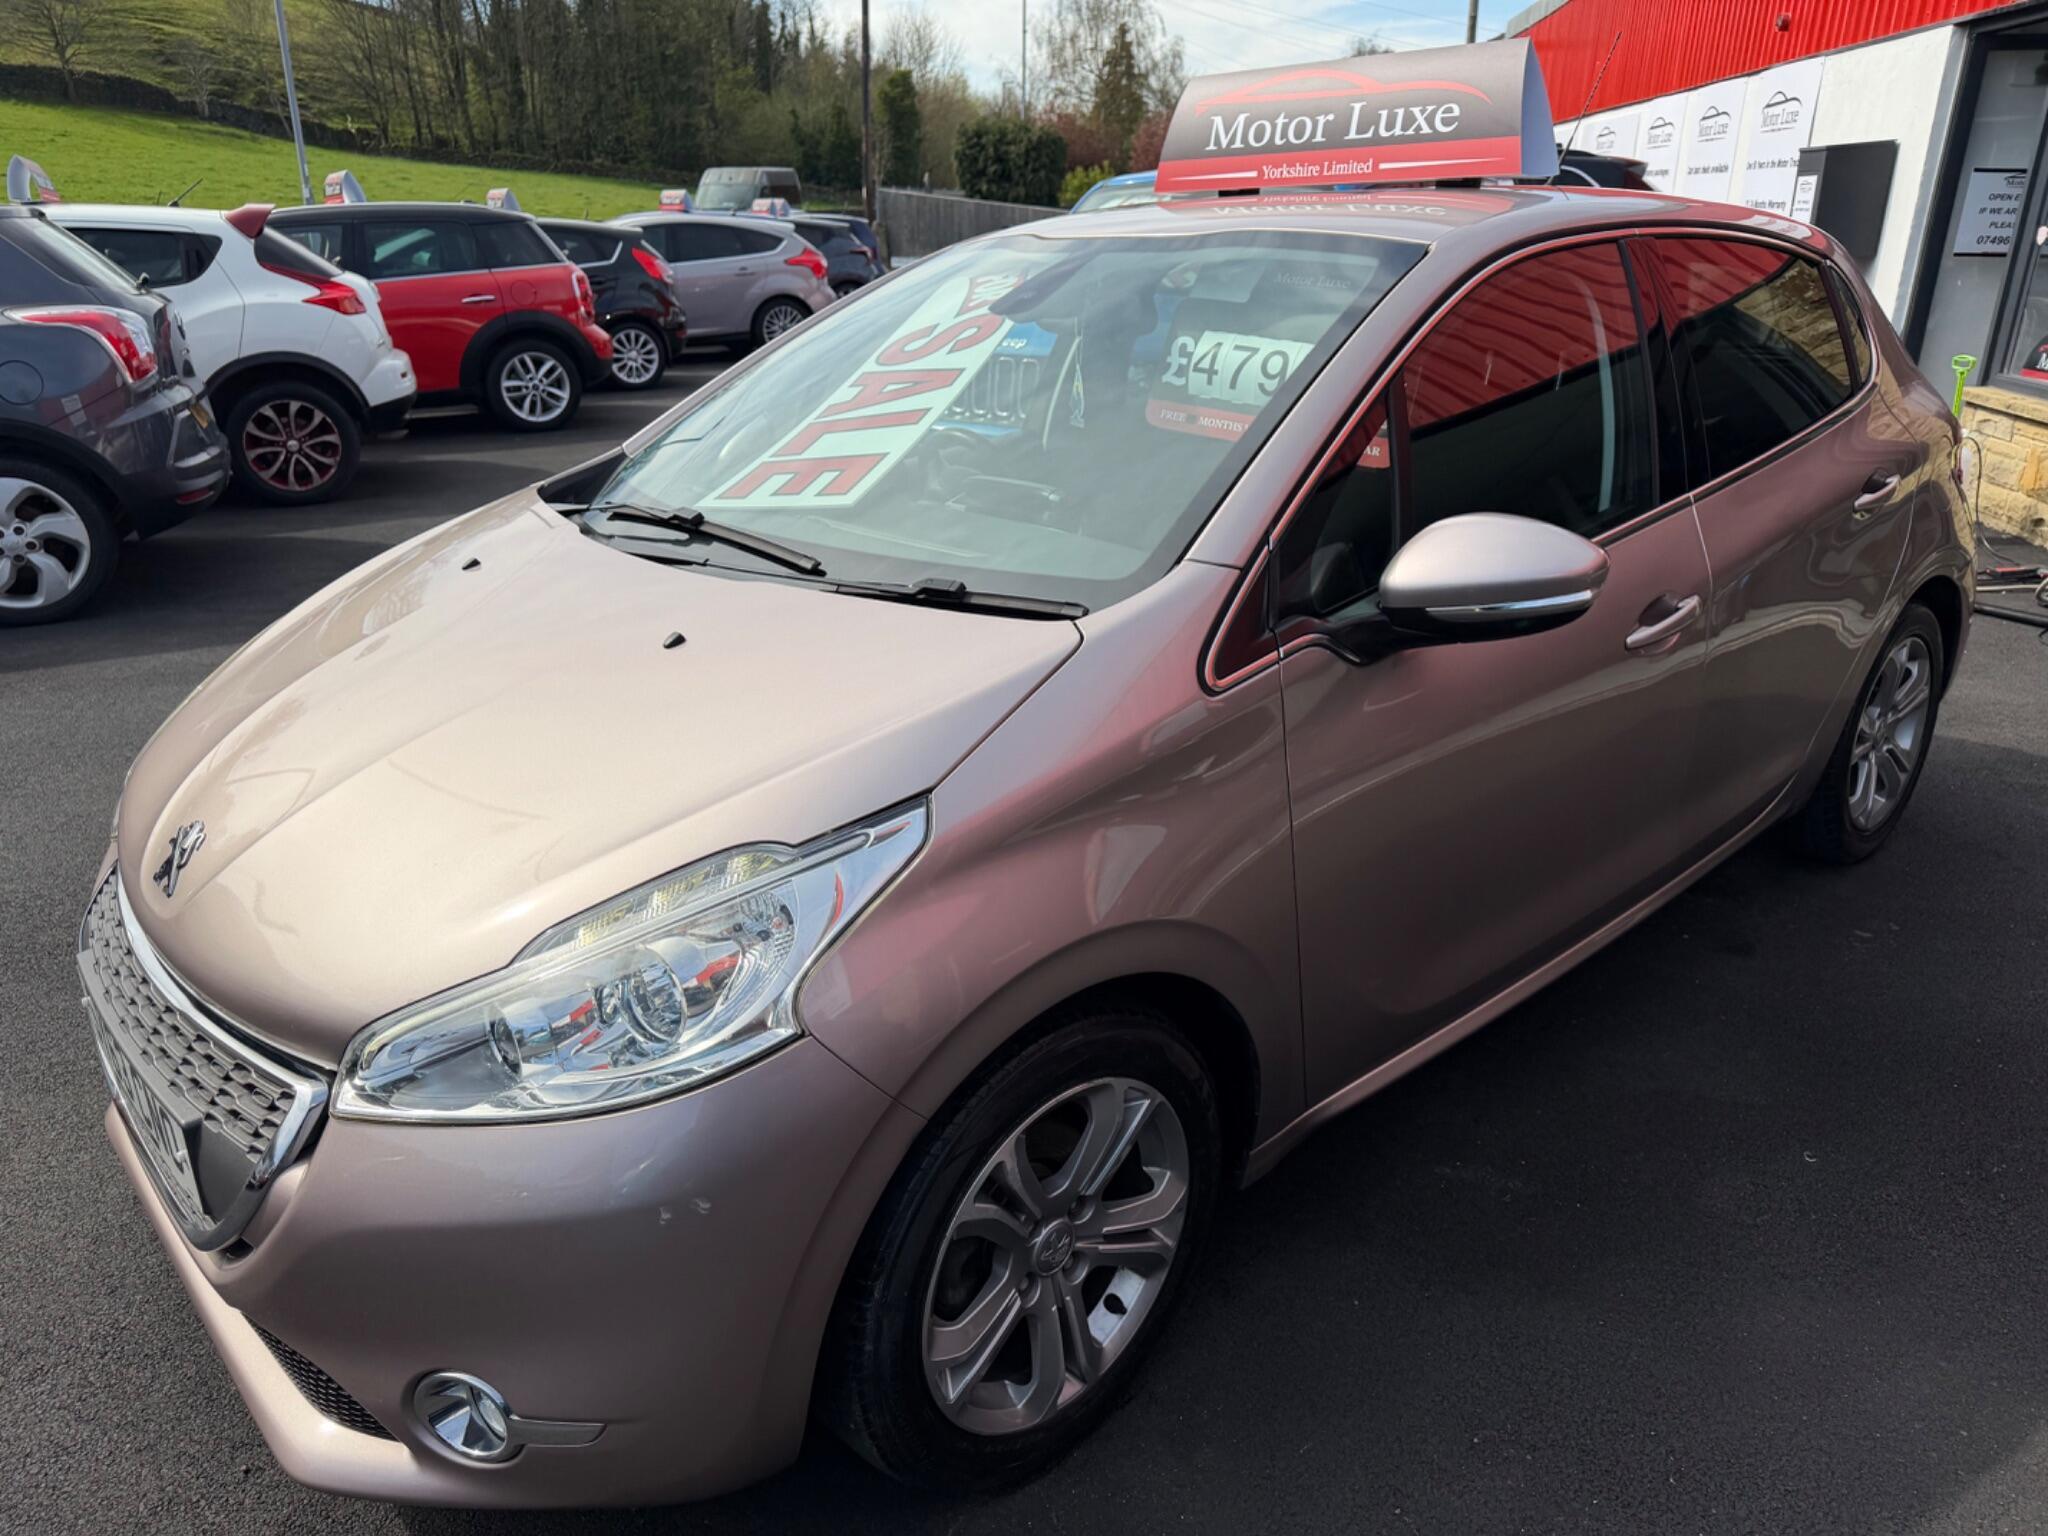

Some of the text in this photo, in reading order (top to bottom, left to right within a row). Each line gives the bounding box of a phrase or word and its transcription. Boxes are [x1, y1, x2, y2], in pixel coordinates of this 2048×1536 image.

[1205, 101, 1461, 151] Motor Luxe
[1262, 158, 1374, 180] Yorkshire Limited
[1988, 193, 2012, 201] OPEN
[1979, 207, 1988, 215] IF
[1989, 207, 2003, 215] WE
[1976, 235, 2011, 245] 07496
[1002, 338, 1028, 350] eep
[713, 311, 1006, 500] SALE
[1160, 408, 1243, 433] FREE MONTHS
